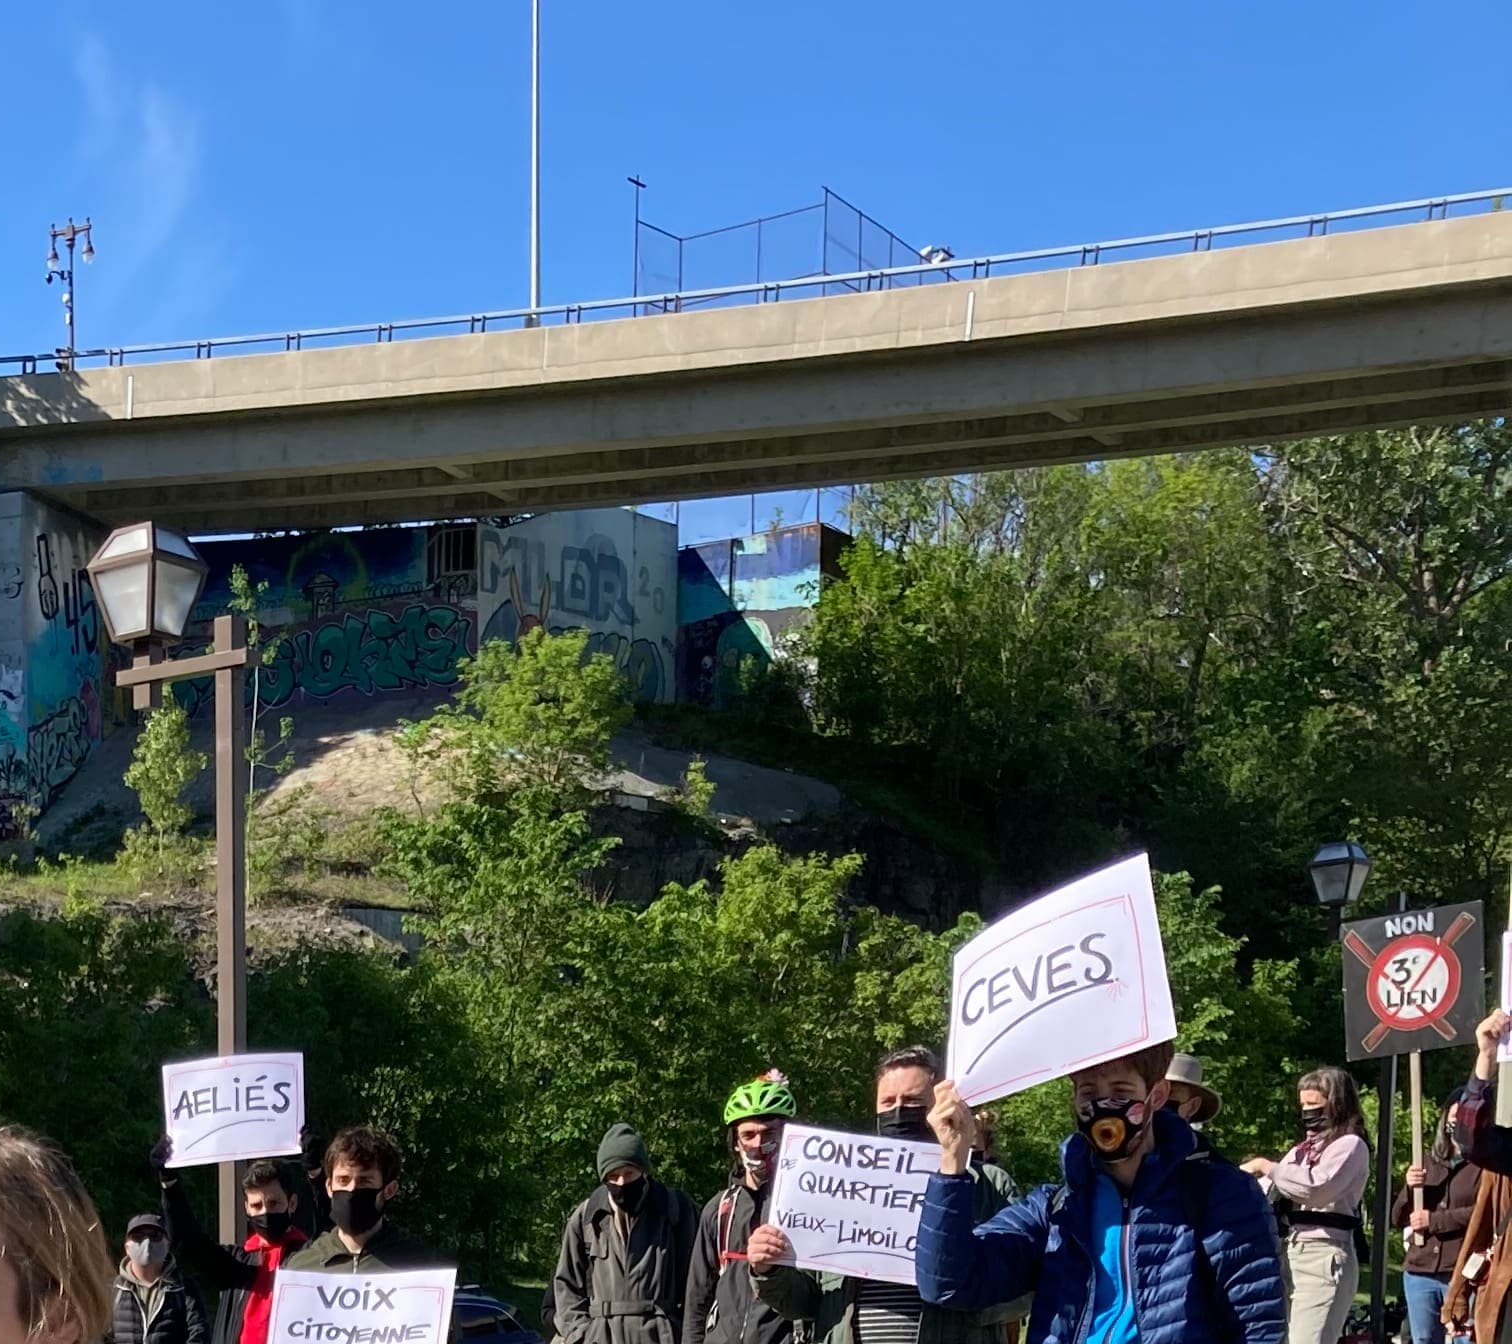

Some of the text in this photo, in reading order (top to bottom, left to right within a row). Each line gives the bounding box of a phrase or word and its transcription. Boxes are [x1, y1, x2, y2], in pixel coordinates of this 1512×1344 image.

[1384, 912, 1434, 938] NON
[961, 933, 1114, 1026] CEVES
[780, 1158, 798, 1170] DE
